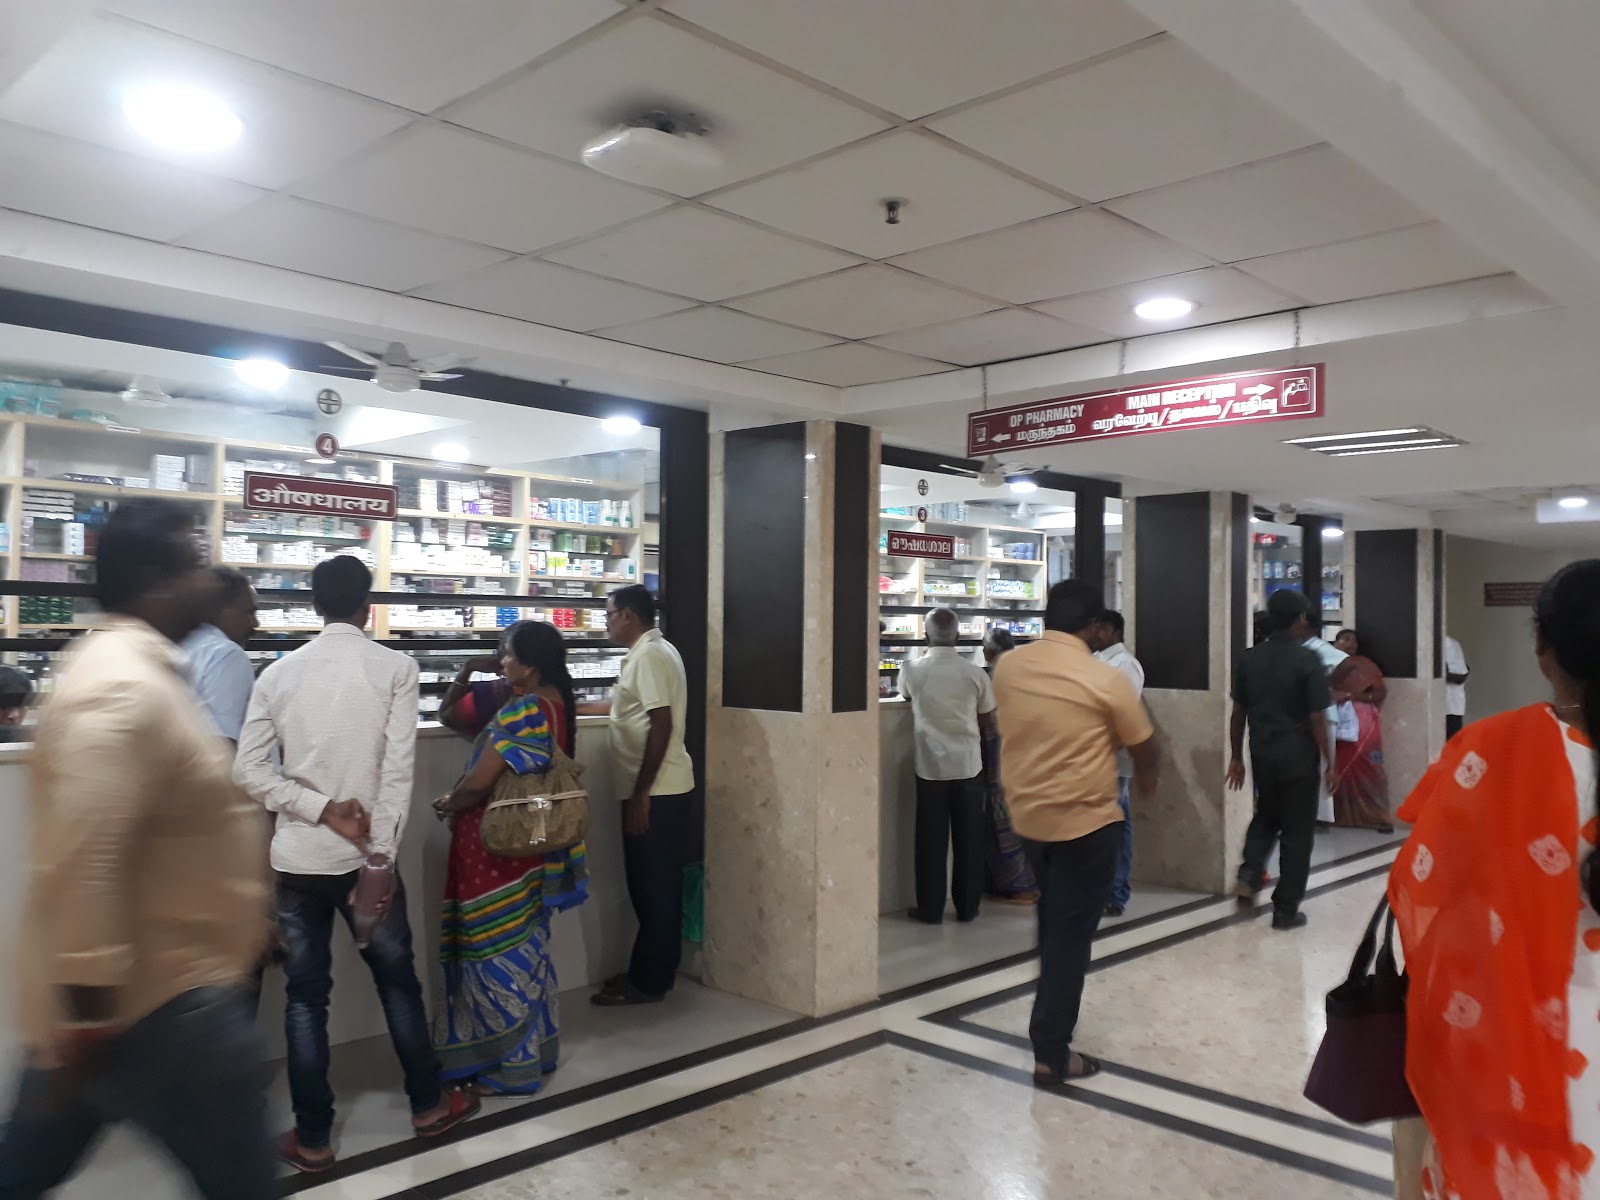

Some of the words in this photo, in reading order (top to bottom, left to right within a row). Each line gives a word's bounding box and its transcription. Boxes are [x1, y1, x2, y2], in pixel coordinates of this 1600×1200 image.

[1126, 393, 1161, 410] MAIN
[1009, 414, 1023, 428] OP
[1026, 404, 1085, 425] PHARMACY
[1016, 419, 1076, 442] மருந்தகம்
[321, 438, 334, 454] 4
[253, 483, 390, 513] औषधालय
